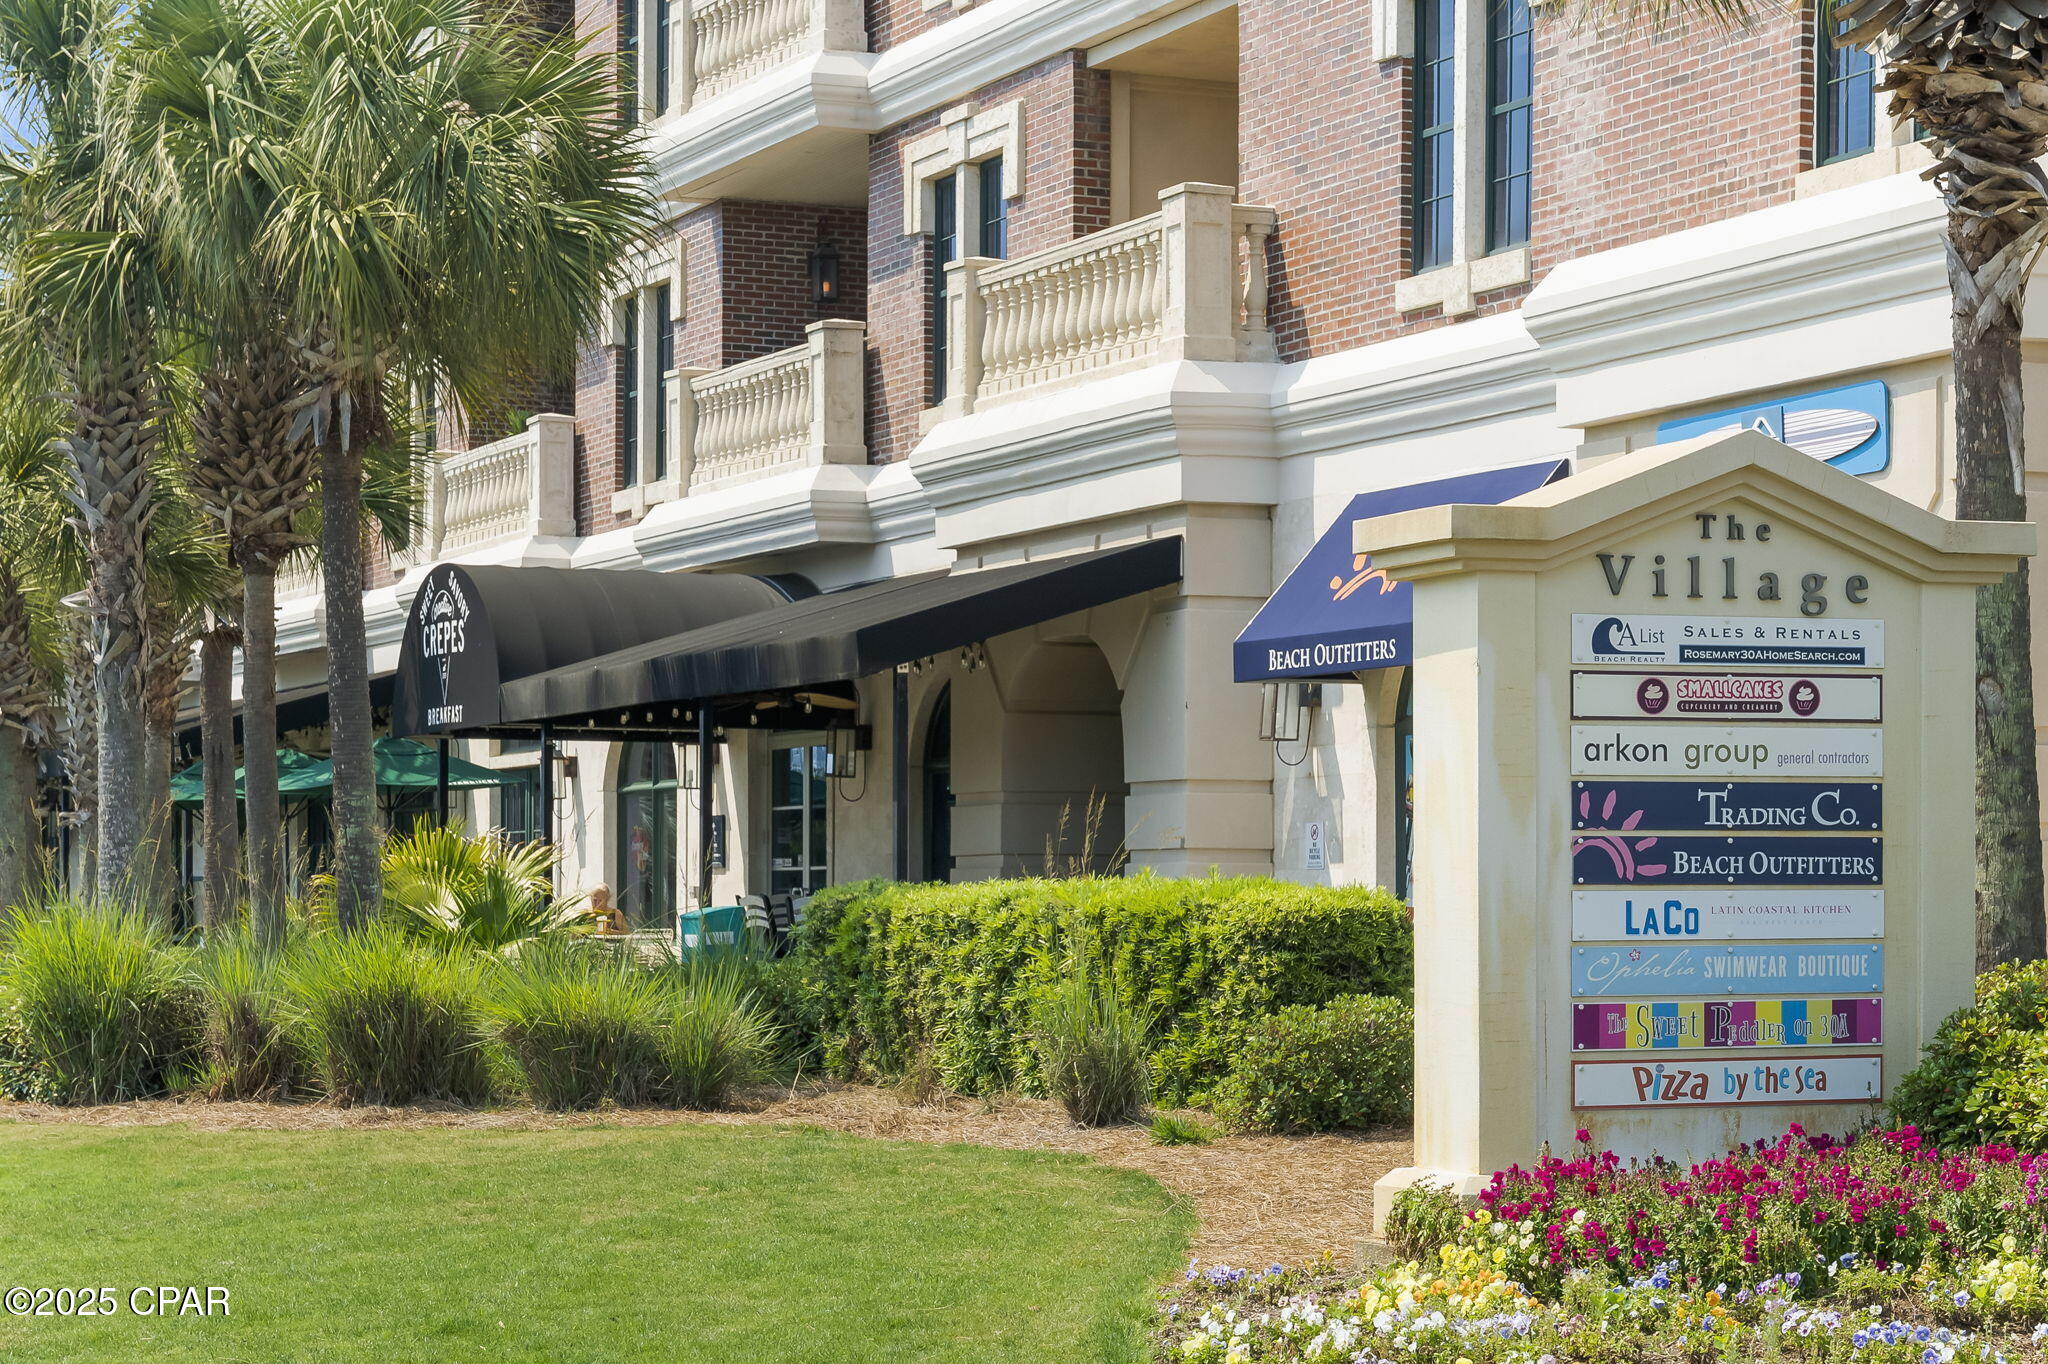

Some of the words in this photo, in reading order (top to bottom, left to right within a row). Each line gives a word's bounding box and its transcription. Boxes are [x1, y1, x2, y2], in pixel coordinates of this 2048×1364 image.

[1696, 513, 1771, 542] The
[420, 576, 435, 625] SWEET
[448, 570, 470, 623] SAVORY
[1596, 553, 1869, 616] Village
[423, 619, 465, 659] CREPES
[1617, 622, 1638, 647] A
[1640, 628, 1665, 644] List
[1684, 625, 1745, 639] SALES
[1754, 626, 1766, 639] &
[1776, 627, 1862, 641] RENTALS
[1269, 647, 1311, 671] BEACH
[1314, 638, 1397, 666] OUTFITTERS
[1676, 679, 1784, 700] SMALLCAKES
[427, 704, 464, 726] BREAKFAST
[1584, 733, 1668, 762] arkon
[1684, 743, 1769, 770] group
[1777, 749, 1814, 768] general
[1818, 751, 1870, 765] contractors
[1697, 788, 1806, 826] TRADING
[1673, 851, 1745, 875] BEACH
[1749, 851, 1876, 876] OUTFITTERS
[1711, 906, 1744, 914] LATIN
[1748, 905, 1800, 914] COASTAL
[1804, 905, 1852, 914] KITCHEN
[1587, 948, 1697, 994] Ophelia
[1704, 955, 1788, 978] SWIMWEAR
[1797, 955, 1869, 978] BOUTIQUE
[1794, 1019, 1813, 1037] on
[1820, 1013, 1850, 1038] 30A
[1632, 1064, 1710, 1102] Pizza
[1723, 1067, 1749, 1100] by
[1754, 1065, 1789, 1094] the
[1795, 1065, 1828, 1094] Sea
